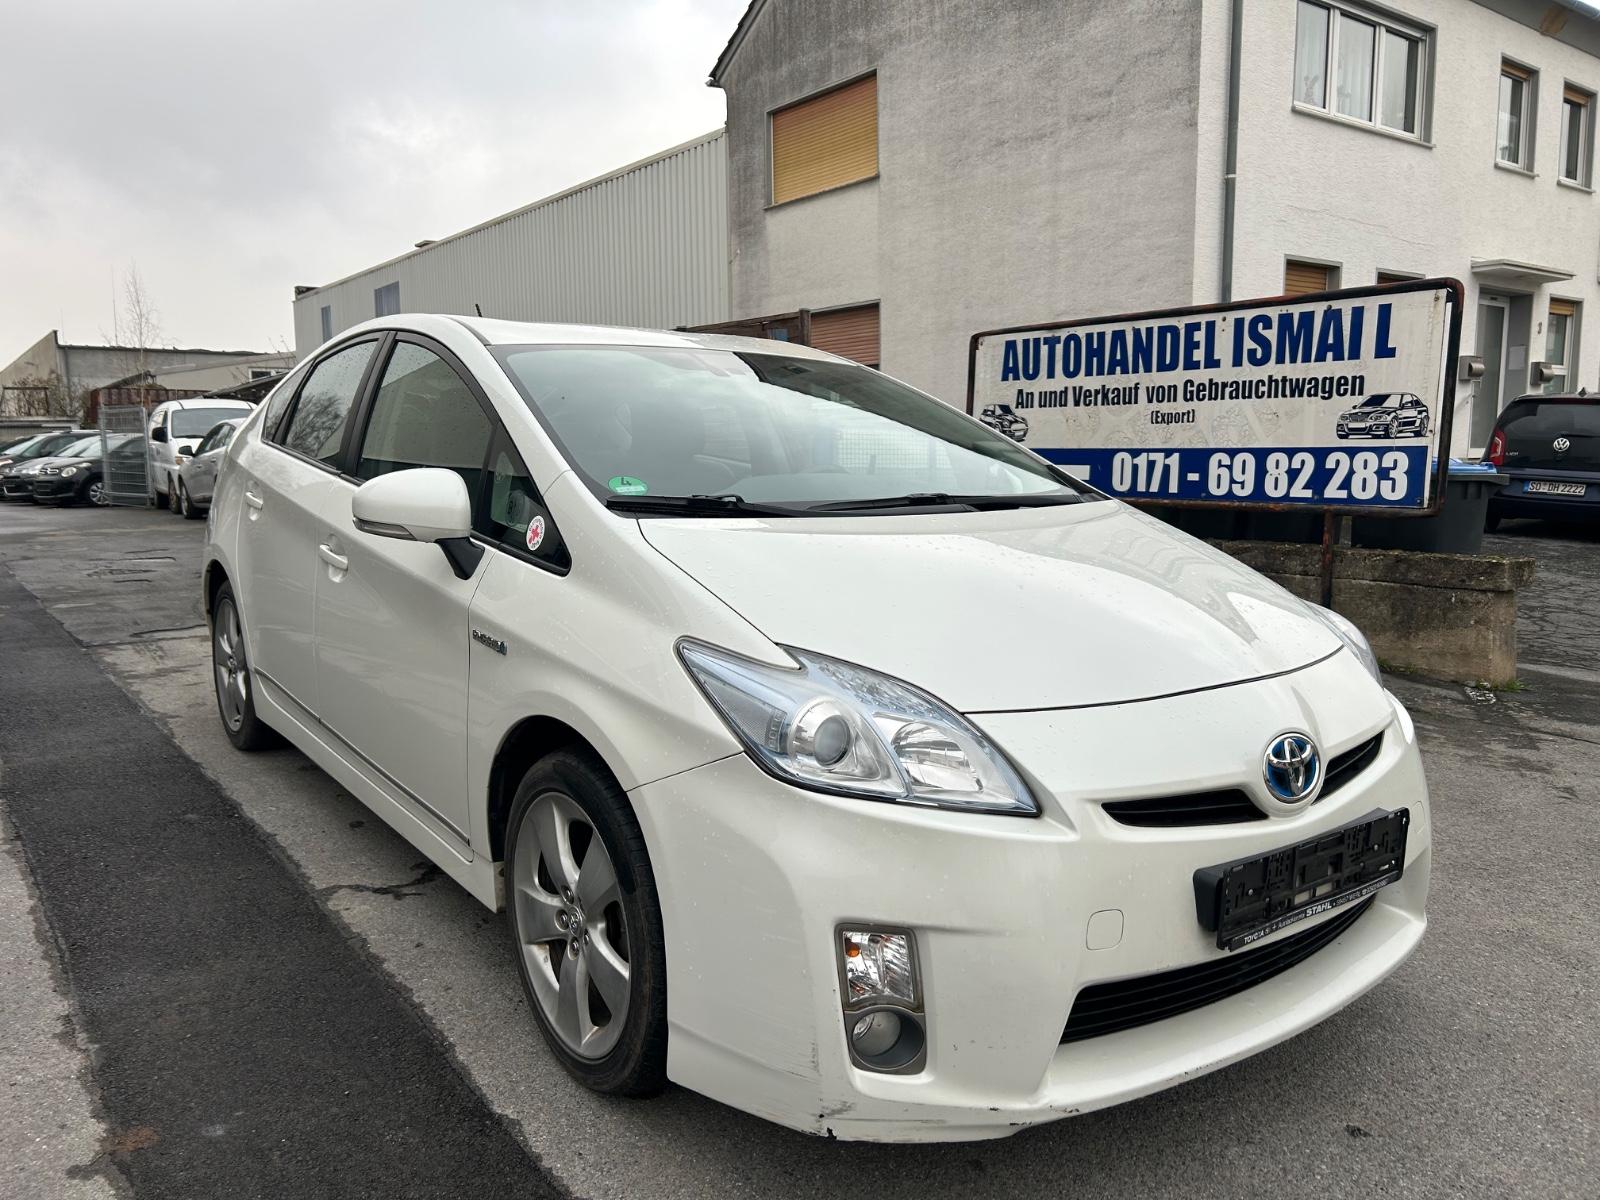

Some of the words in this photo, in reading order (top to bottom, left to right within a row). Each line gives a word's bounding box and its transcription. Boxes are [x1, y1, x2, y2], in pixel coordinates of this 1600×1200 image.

[1001, 320, 1221, 382] AUTOHANDEL
[1015, 388, 1035, 409] An
[1038, 386, 1068, 408] und
[1072, 382, 1140, 406] Verkauf
[1146, 383, 1178, 404] von
[1183, 374, 1365, 402] Gebrauchtwagen
[1150, 409, 1195, 425] (Export)
[1111, 451, 1180, 494] 0171
[1207, 452, 1256, 497] 69
[1264, 451, 1315, 498] 82
[1323, 450, 1409, 501] 283
[1560, 483, 1585, 494] 2222
[1306, 901, 1332, 917] STAHL
